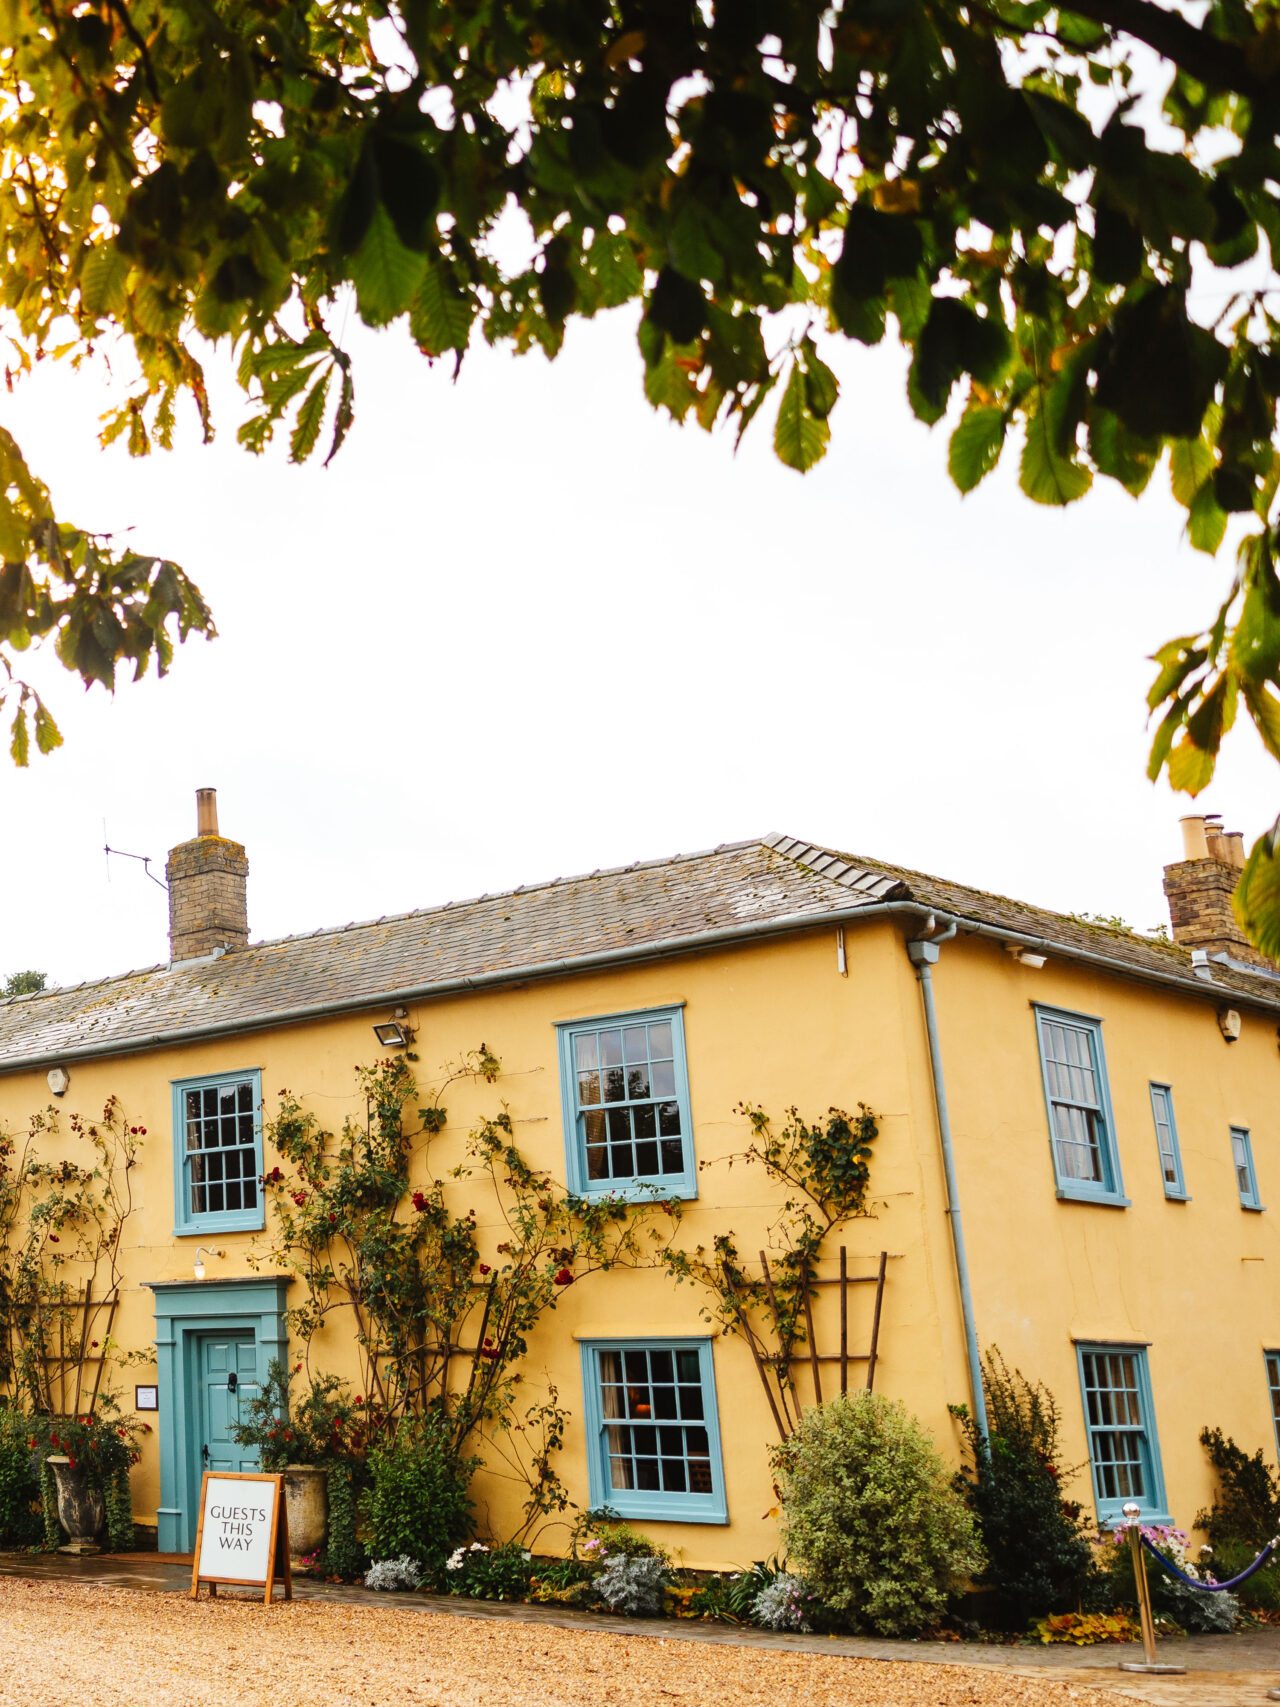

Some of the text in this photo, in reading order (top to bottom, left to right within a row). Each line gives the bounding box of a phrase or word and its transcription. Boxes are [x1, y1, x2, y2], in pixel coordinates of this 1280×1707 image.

[210, 1505, 266, 1522] GUESTS
[221, 1521, 253, 1536] THIS
[219, 1537, 254, 1551] WAY
